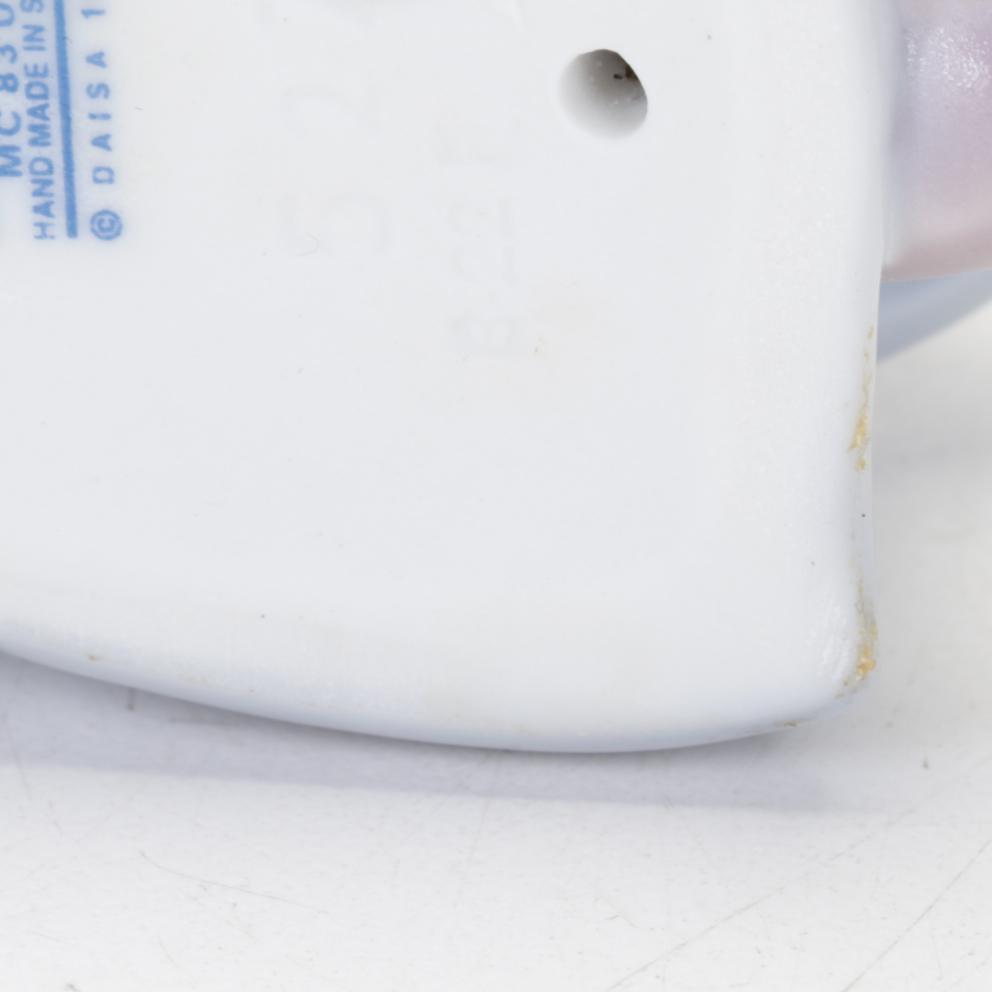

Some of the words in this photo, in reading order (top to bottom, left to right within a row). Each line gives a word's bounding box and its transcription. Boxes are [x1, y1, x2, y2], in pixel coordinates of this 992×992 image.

[23, 24, 45, 51] IN
[25, 63, 51, 147] MADE
[86, 51, 115, 185] DAISA
[29, 155, 56, 240] HAND
